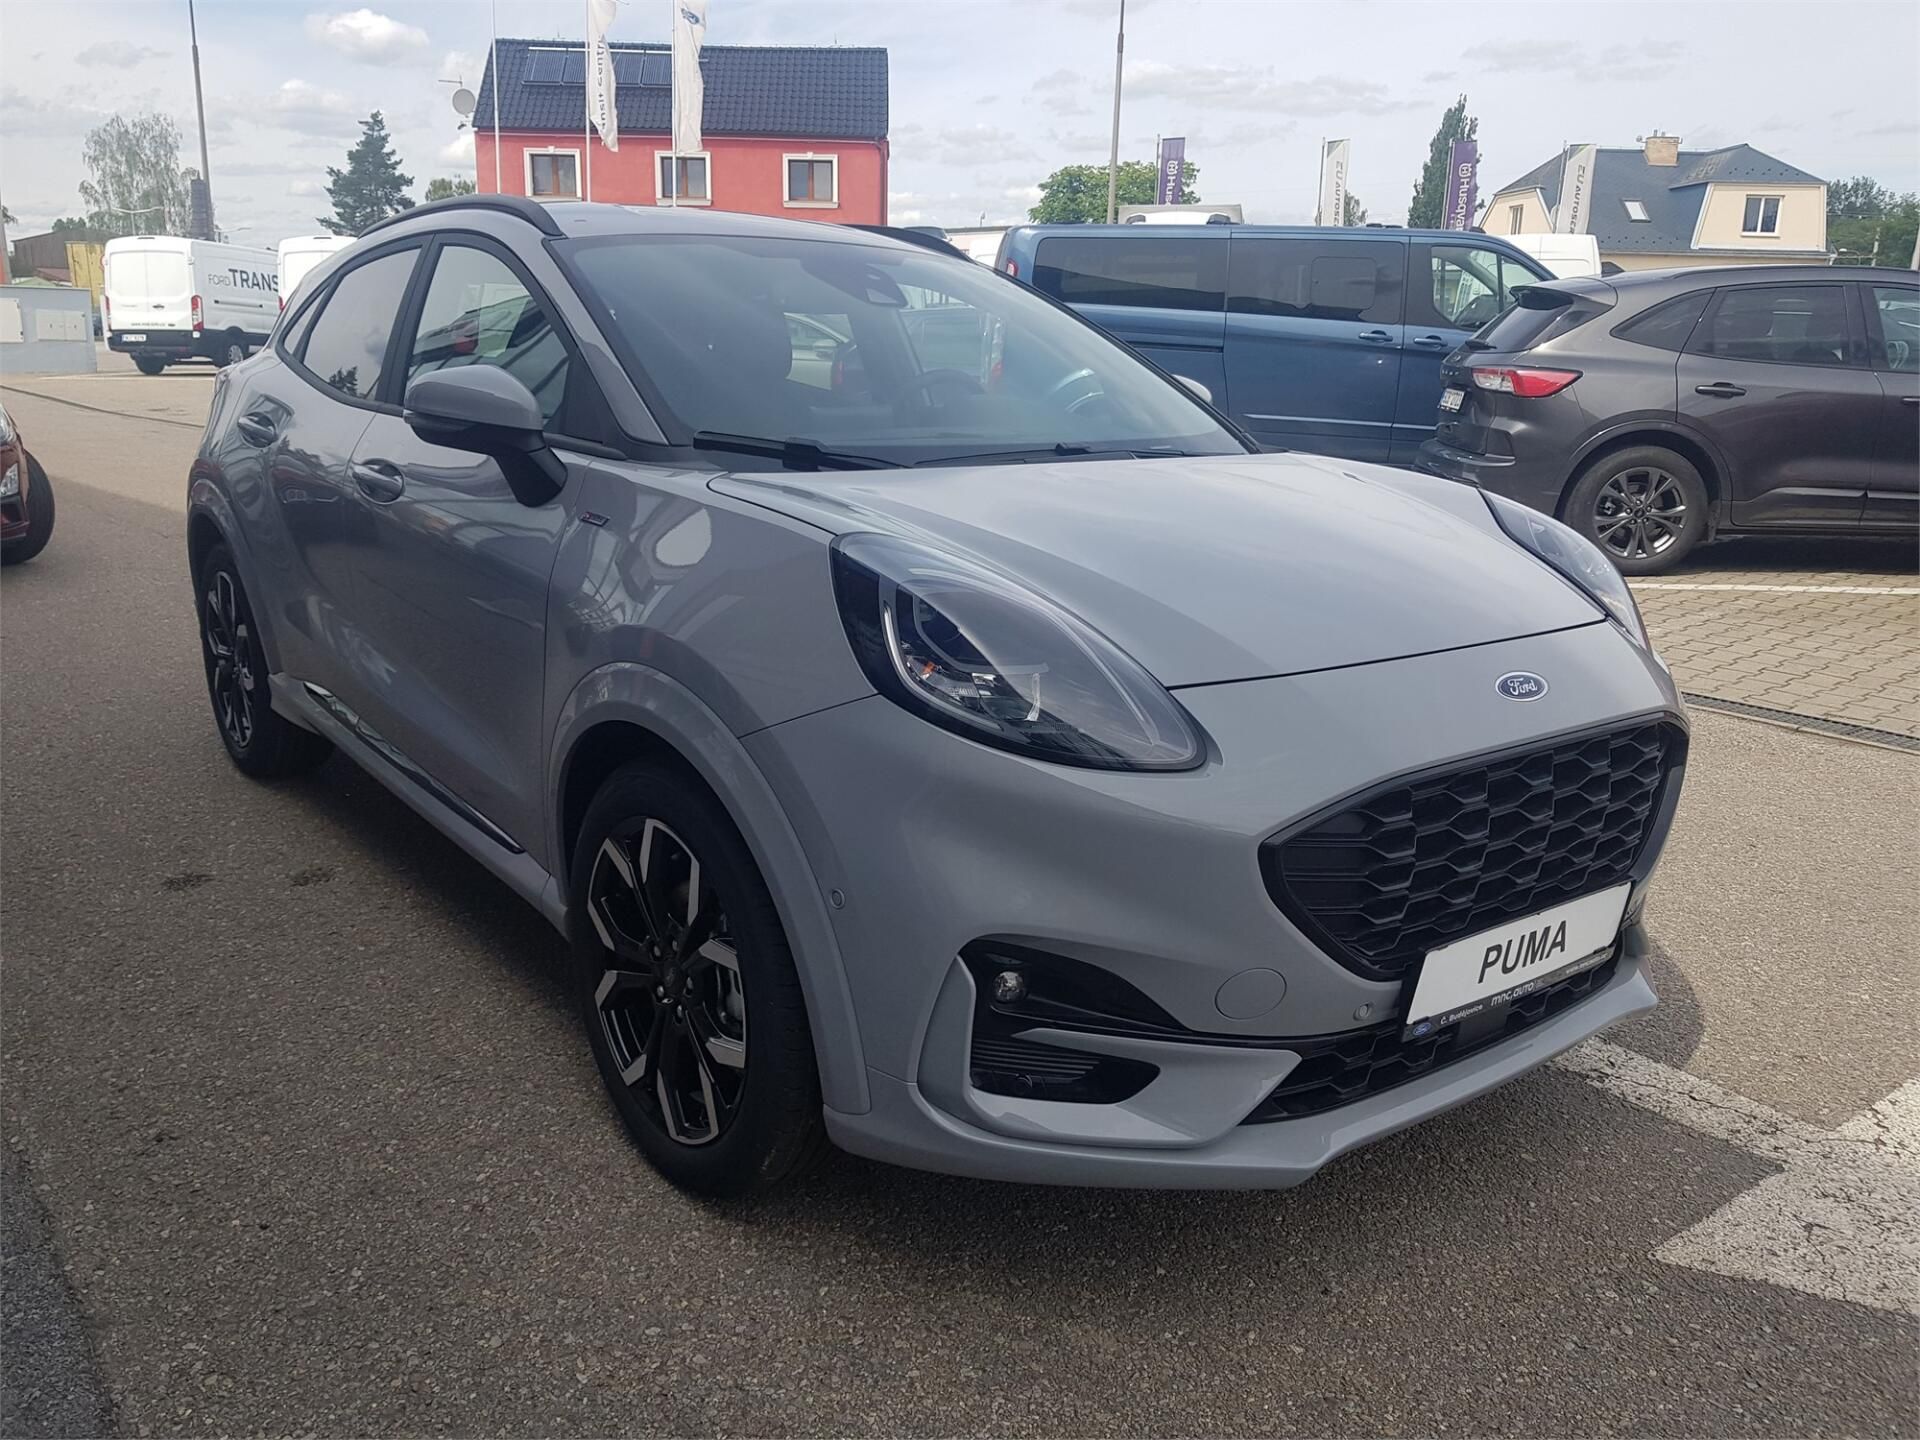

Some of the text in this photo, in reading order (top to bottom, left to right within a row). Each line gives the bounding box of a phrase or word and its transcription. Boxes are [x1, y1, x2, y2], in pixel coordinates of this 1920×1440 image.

[208, 268, 279, 292] FORD TRANS
[1507, 677, 1538, 695] Ford
[1477, 920, 1567, 984] PUMA
